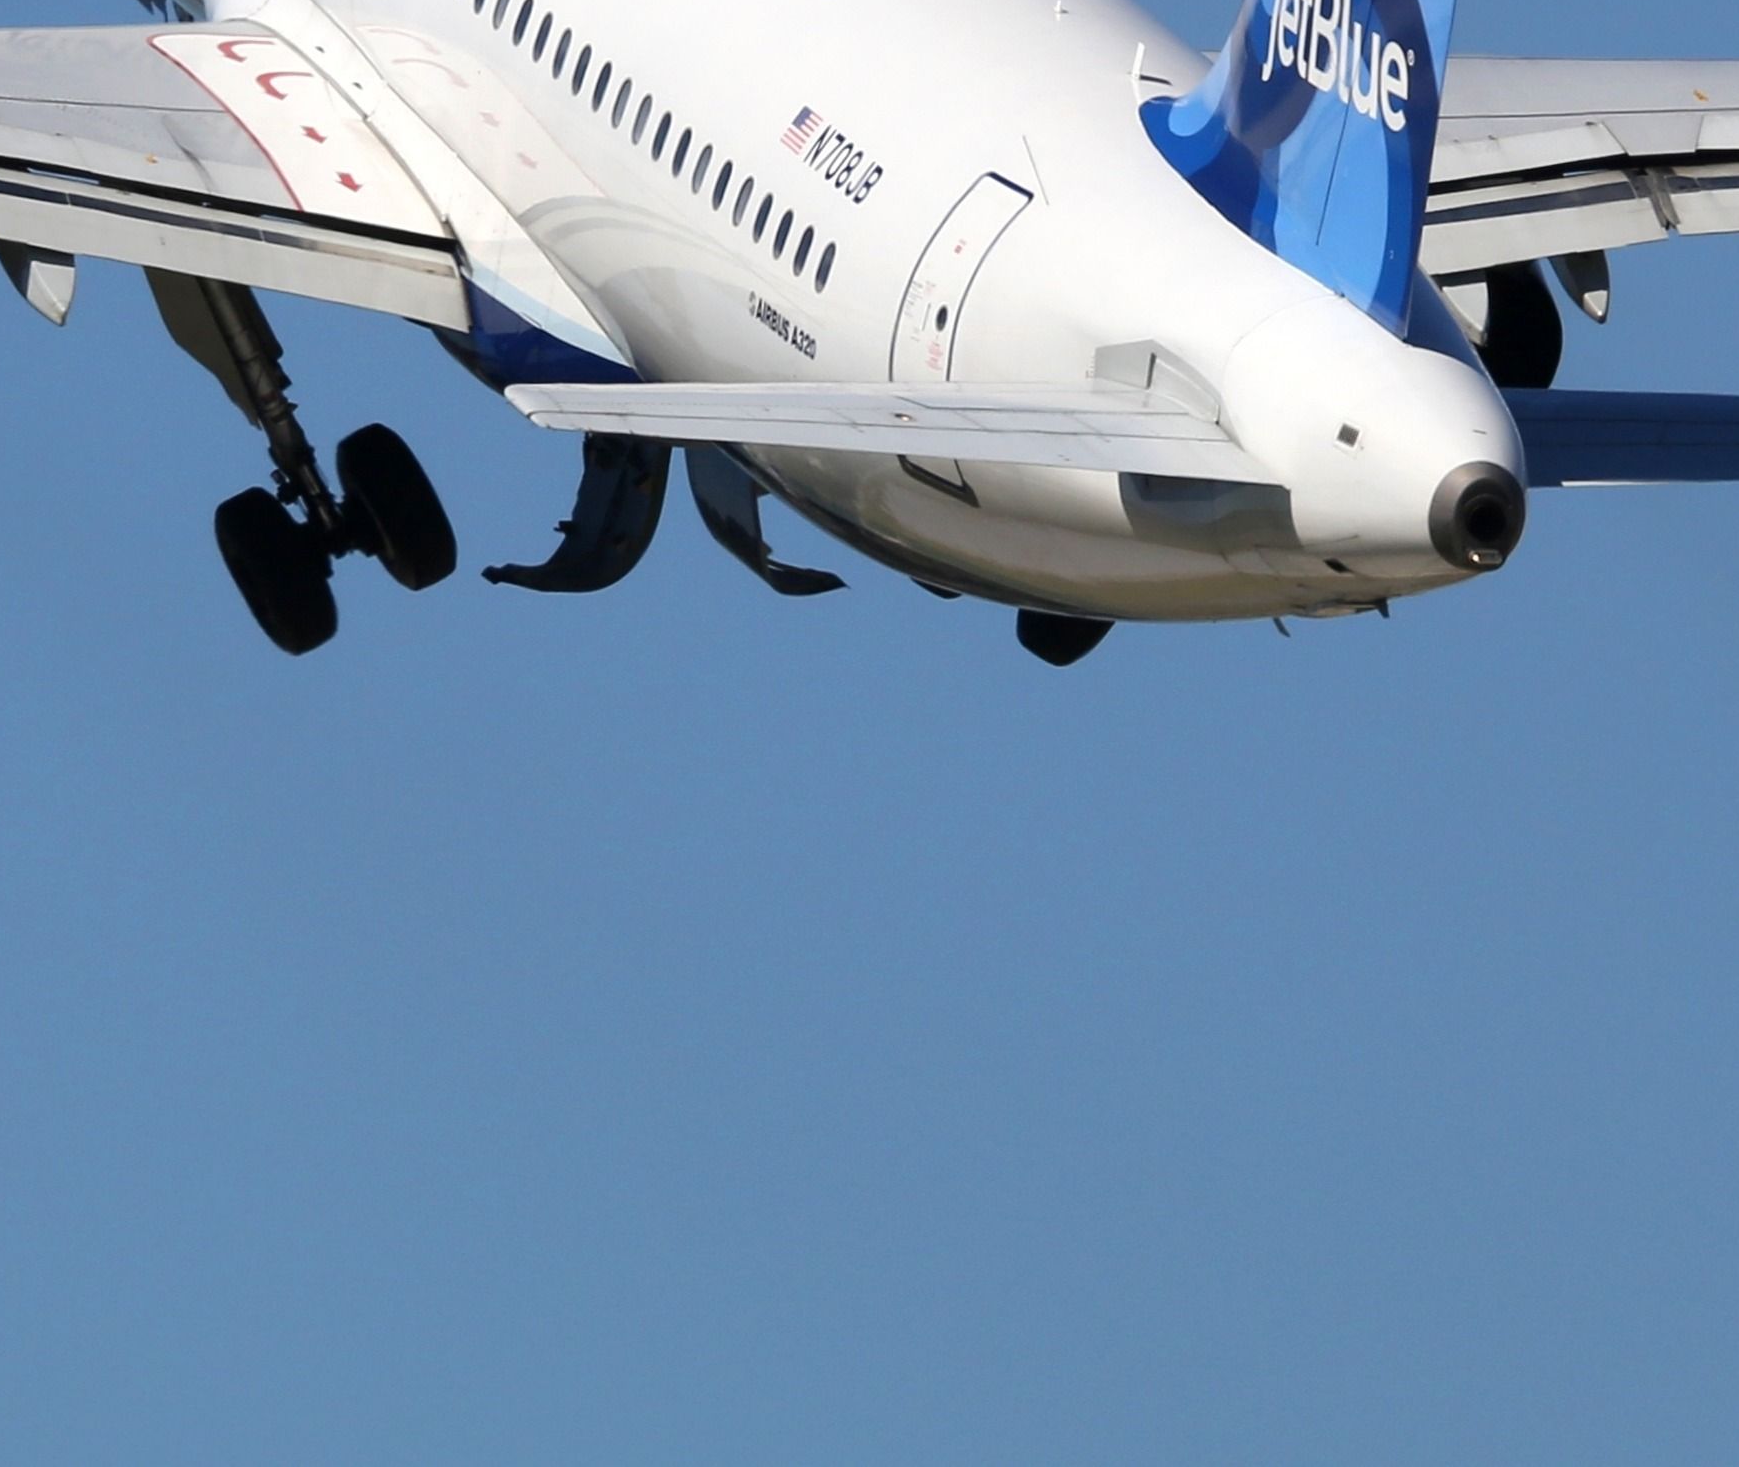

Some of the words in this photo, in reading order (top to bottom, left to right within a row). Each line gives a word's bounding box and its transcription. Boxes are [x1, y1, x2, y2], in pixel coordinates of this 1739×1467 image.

[802, 124, 883, 204] N708JB
[756, 298, 790, 342] AIRBUS
[791, 325, 817, 361] A320
